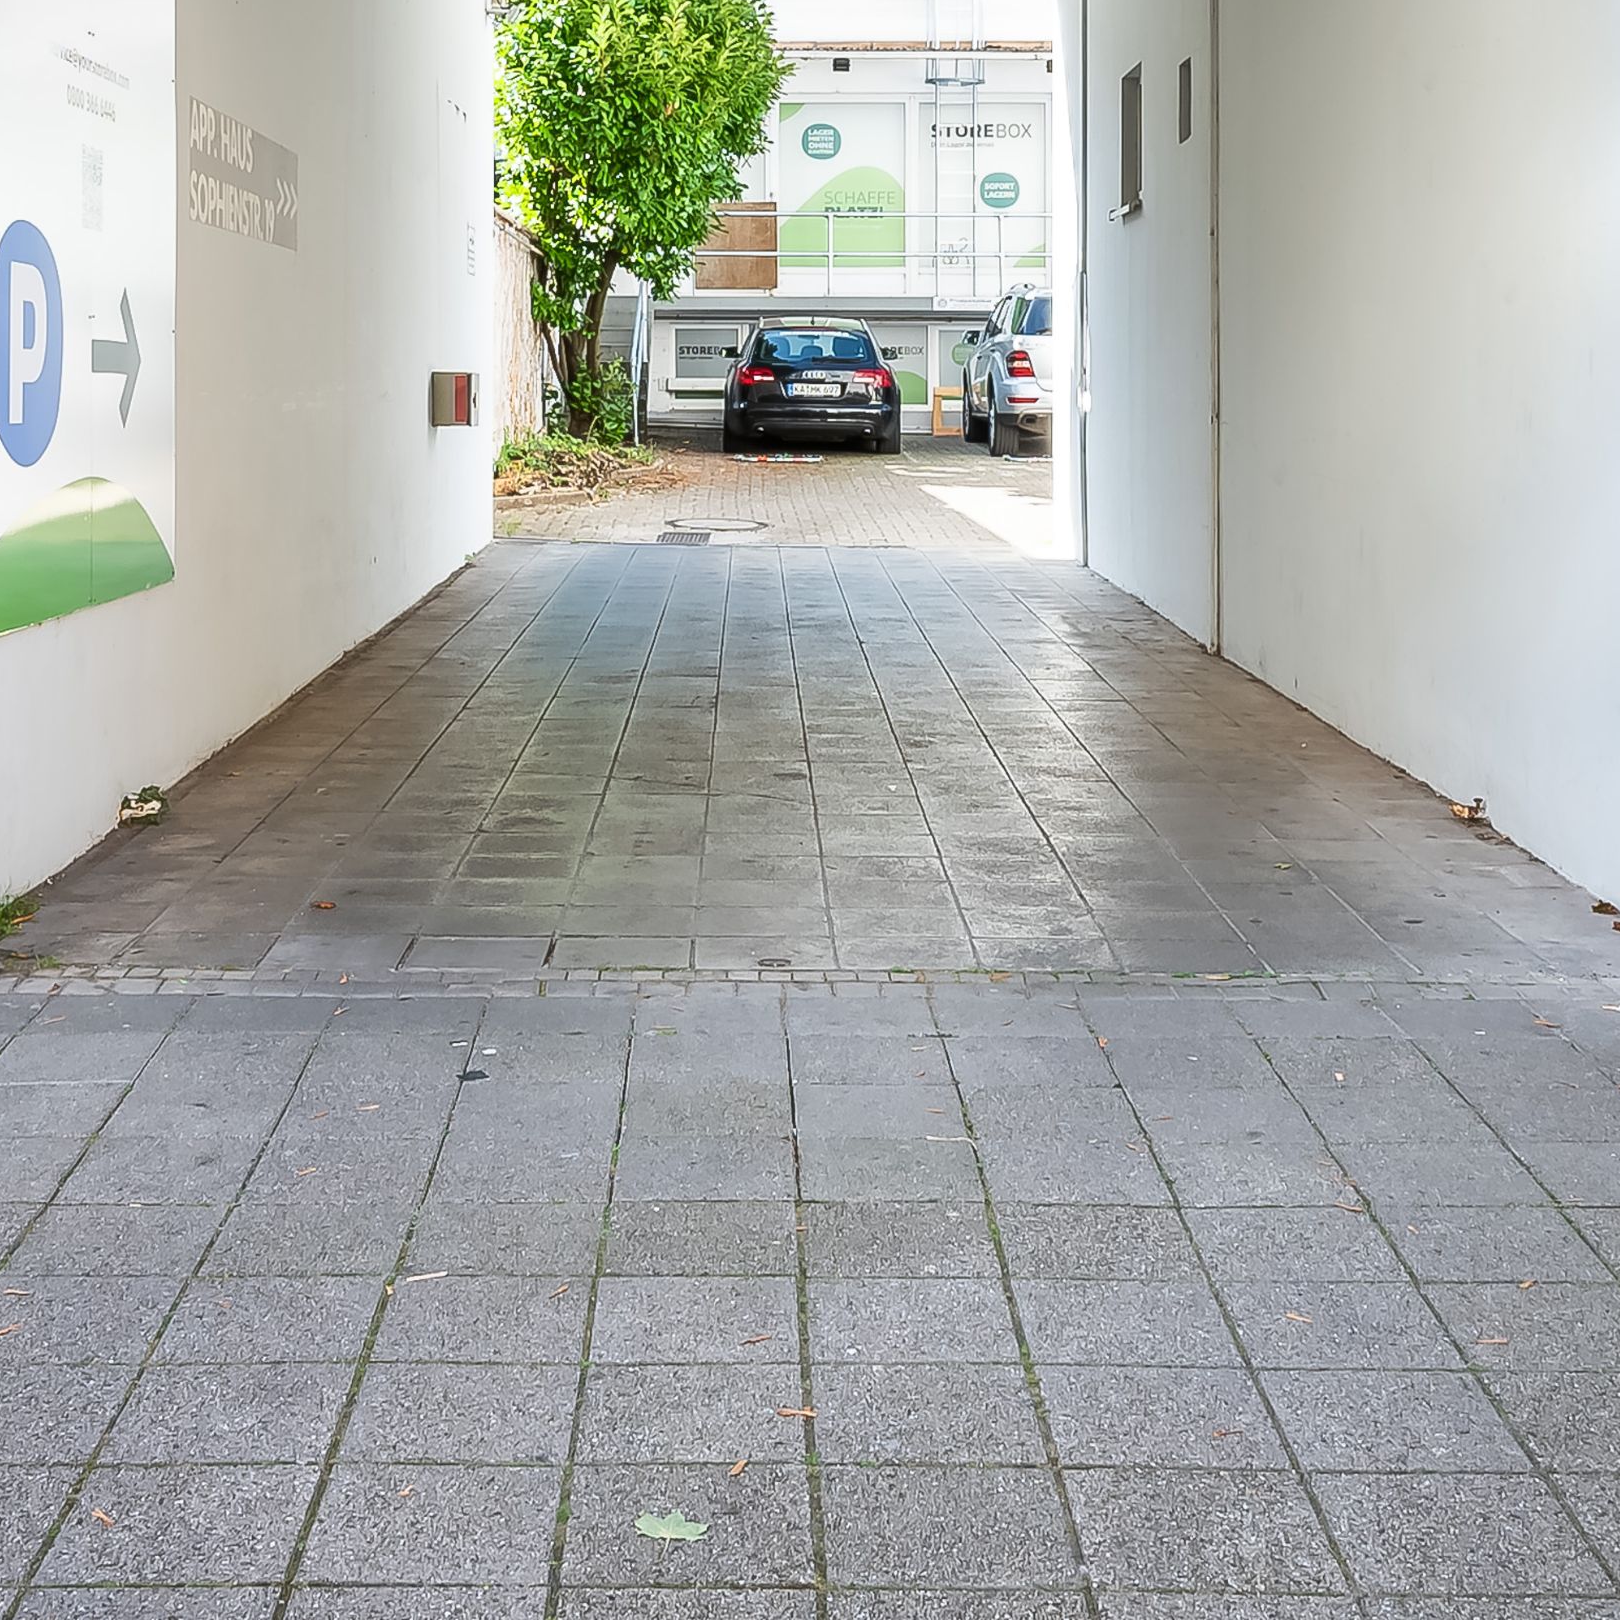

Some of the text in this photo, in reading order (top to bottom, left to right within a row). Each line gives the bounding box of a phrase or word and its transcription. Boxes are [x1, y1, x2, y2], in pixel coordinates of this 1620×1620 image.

[190, 99, 254, 173] APP. HAUS
[931, 123, 1032, 138] STOREBOX
[190, 169, 264, 240] SOPHIENSTR.
[824, 191, 896, 205] SCHAFFE
[8, 260, 49, 425] P
